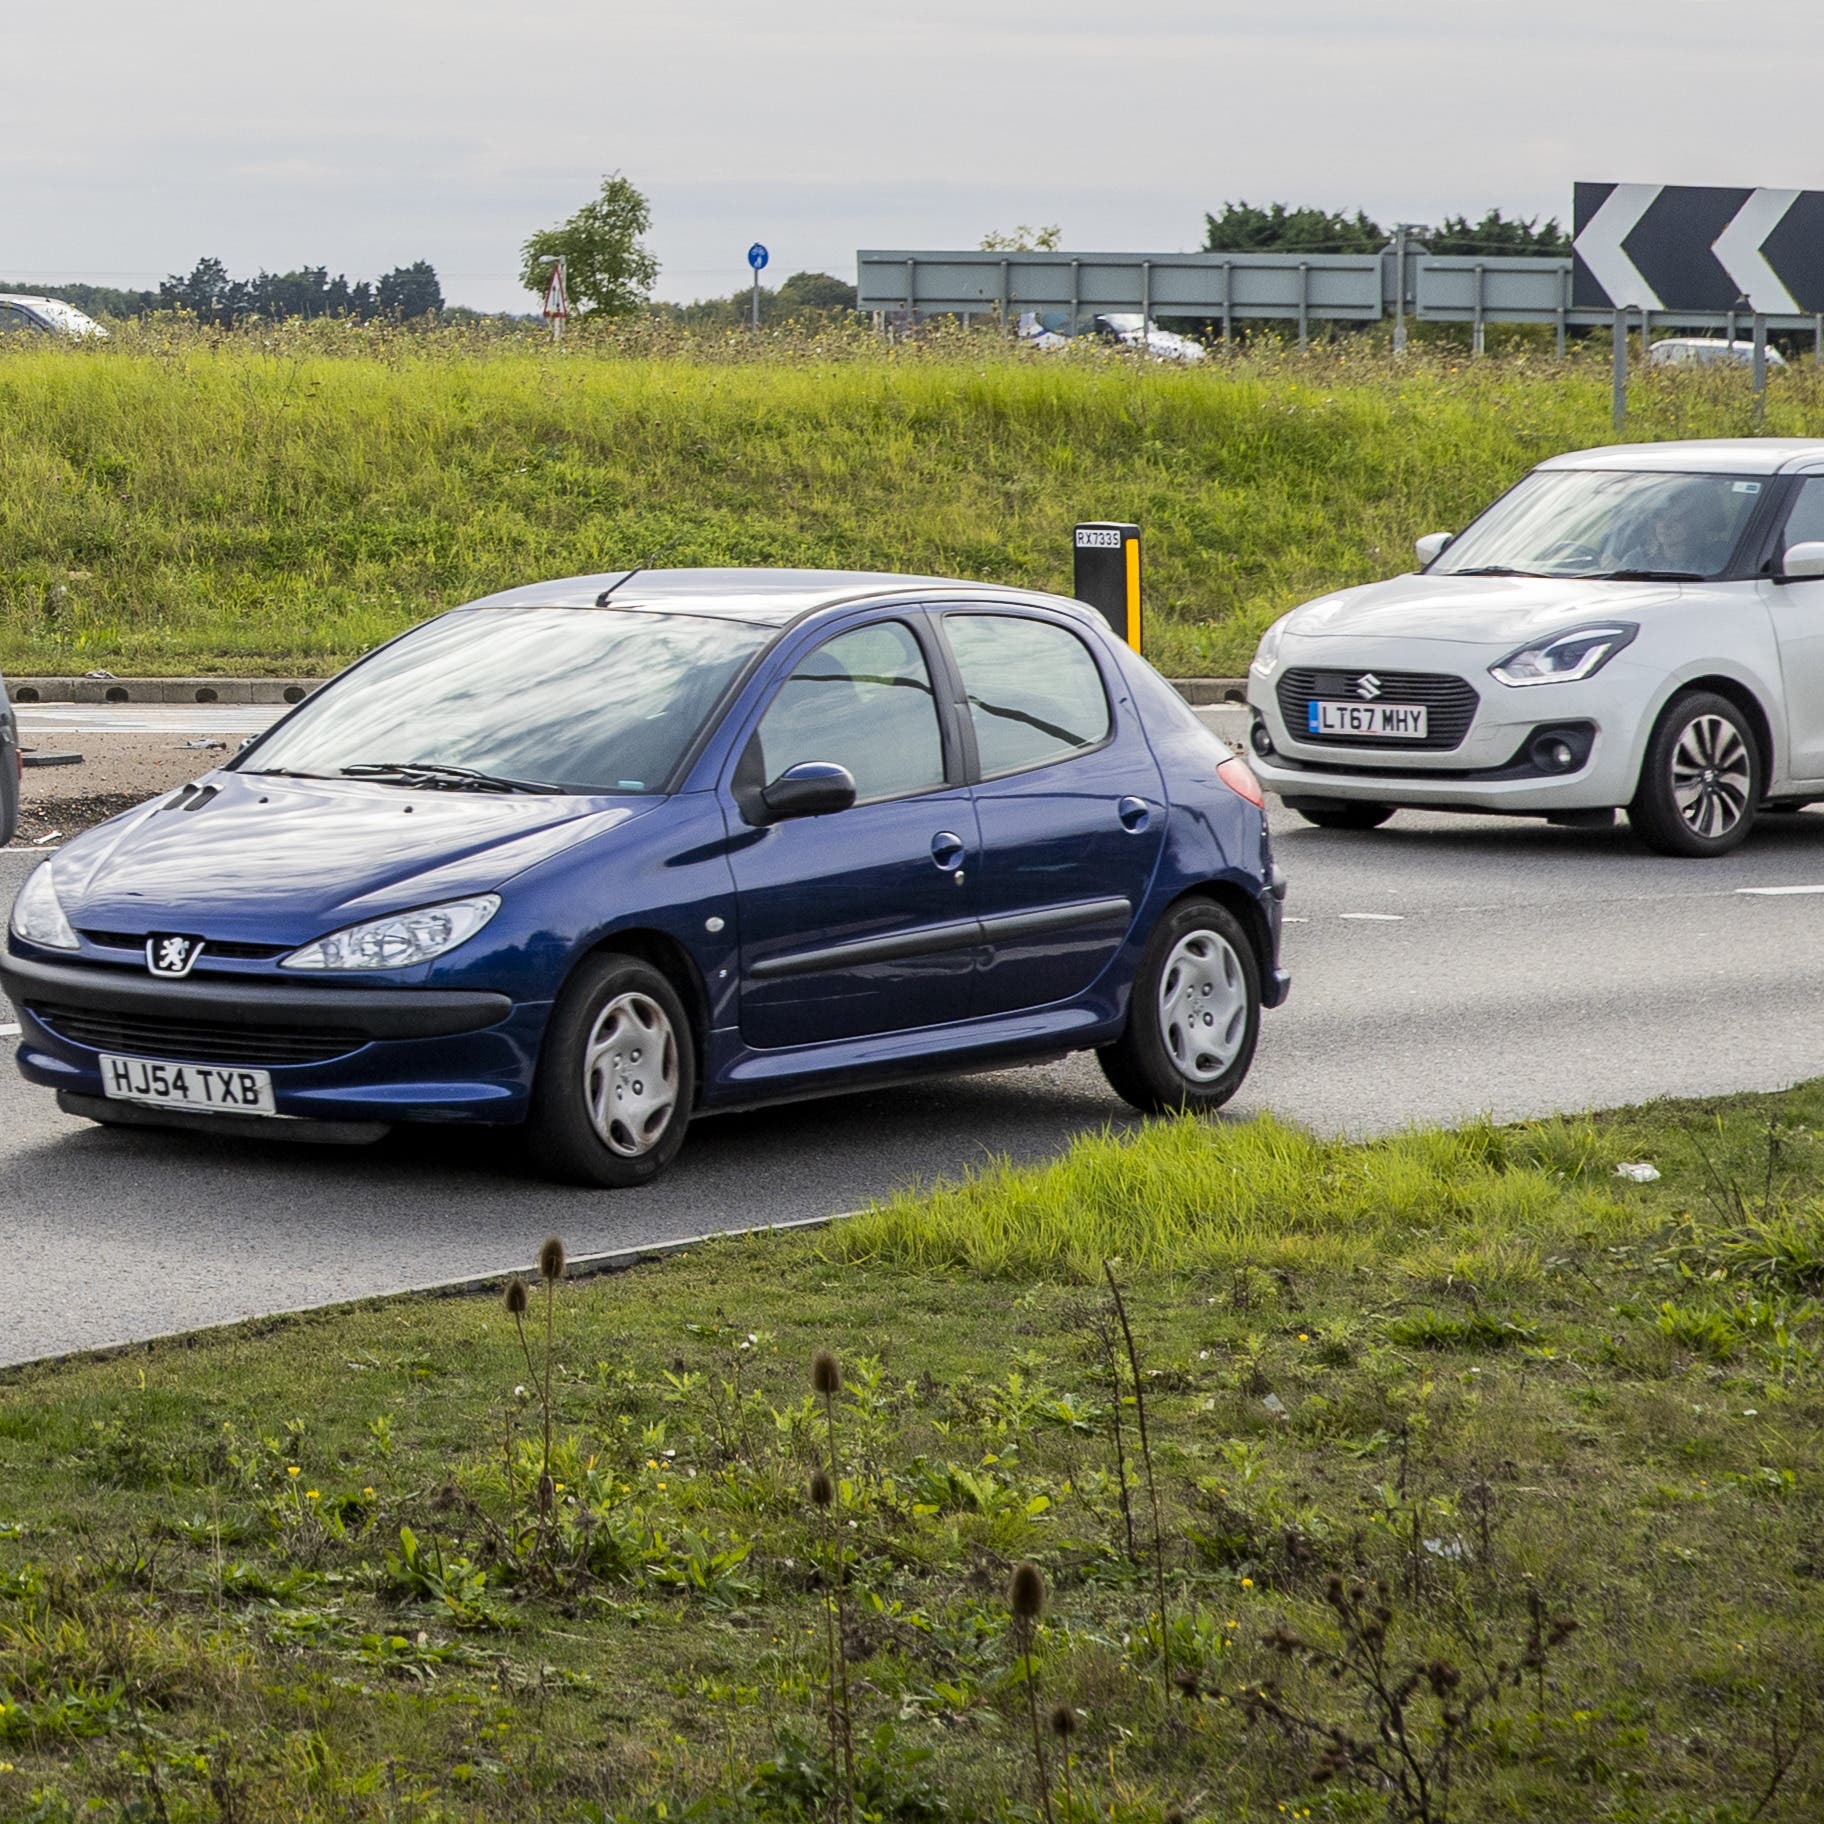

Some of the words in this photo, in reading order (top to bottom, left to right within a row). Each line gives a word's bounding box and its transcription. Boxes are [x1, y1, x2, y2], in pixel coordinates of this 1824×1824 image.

[1322, 706, 1375, 730] LT67
[1382, 709, 1422, 733] MHY
[112, 1060, 190, 1099] HJ54
[196, 1069, 259, 1106] TXB
